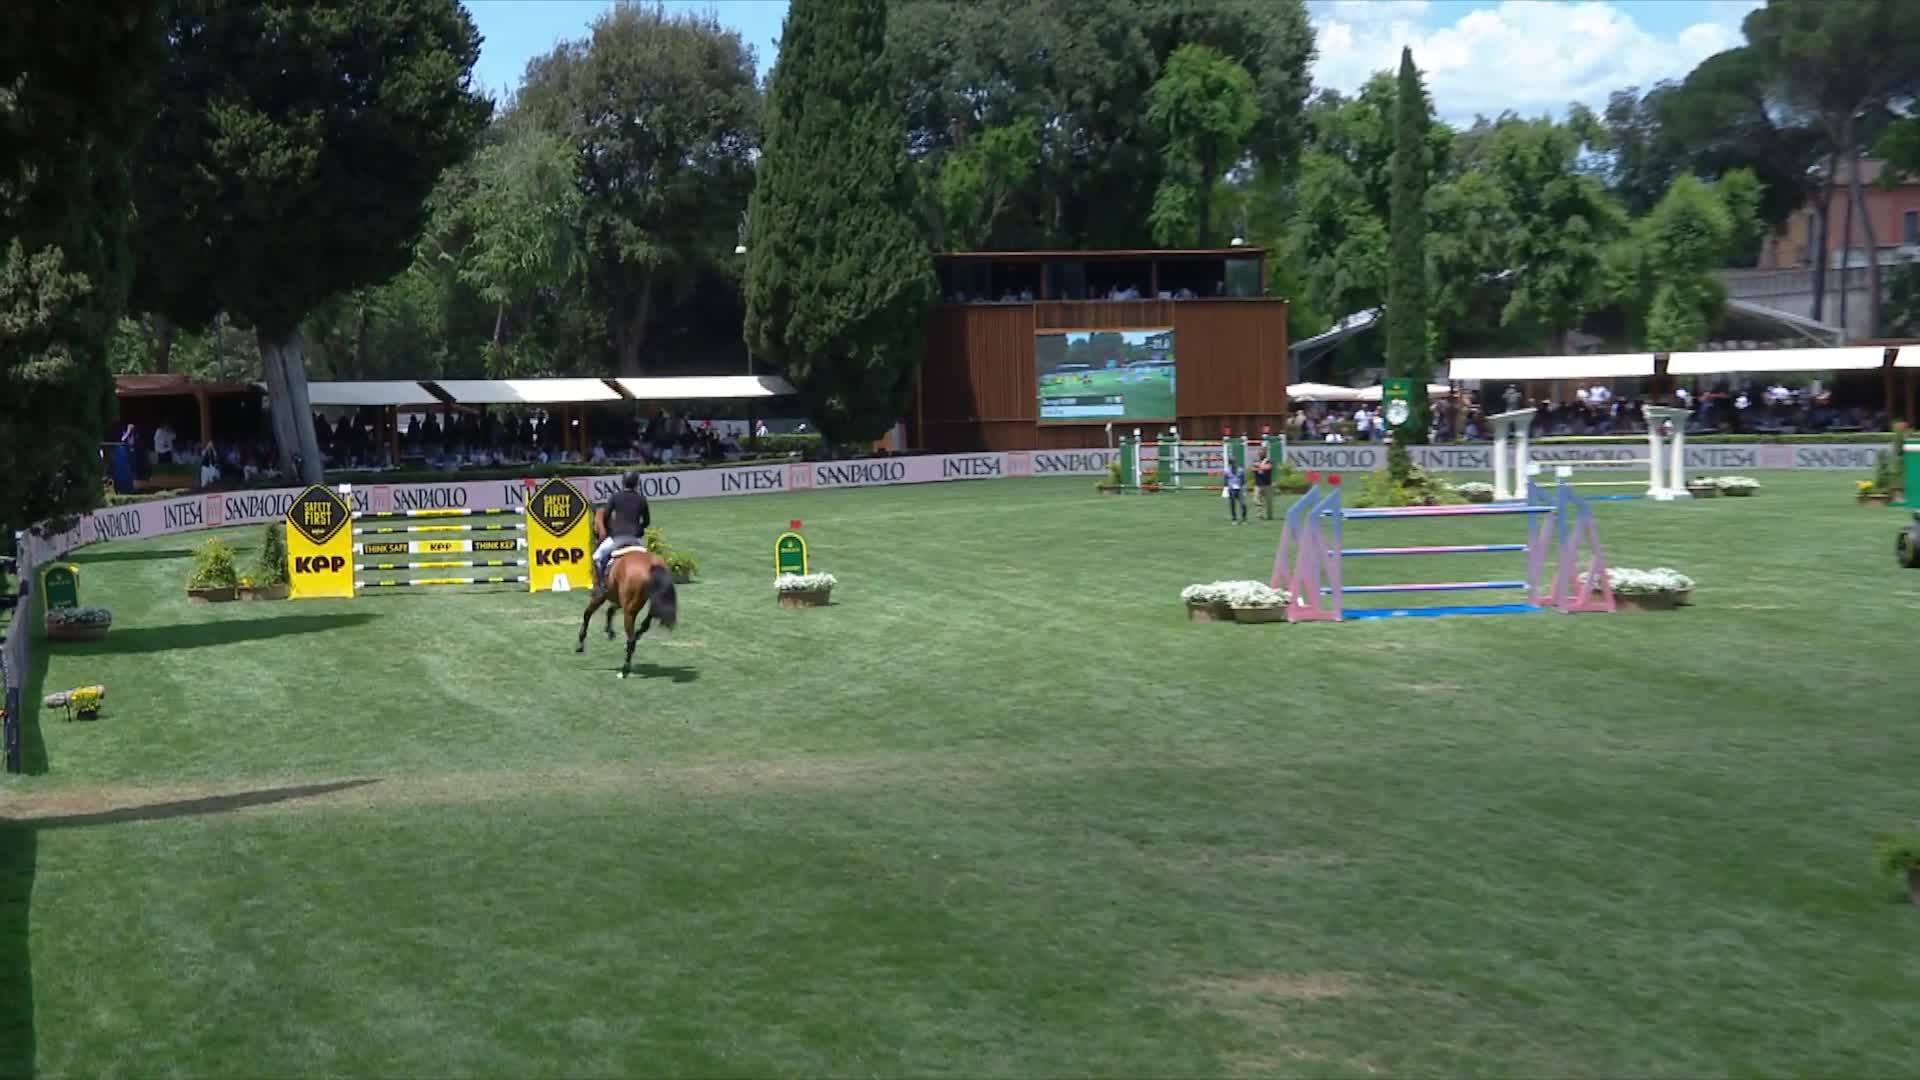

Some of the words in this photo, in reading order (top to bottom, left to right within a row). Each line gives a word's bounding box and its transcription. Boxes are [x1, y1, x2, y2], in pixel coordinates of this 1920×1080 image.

[1421, 449, 1490, 468] INTESA
[943, 456, 1001, 478] INTESA
[721, 469, 783, 492] INTESA
[817, 461, 905, 486] SANPAOLO
[304, 501, 331, 512] SAFETY
[393, 486, 467, 511] SANPAOLO
[164, 502, 202, 529] INTESA
[225, 493, 294, 521] SANPAOLO
[304, 512, 332, 525] FIRST
[544, 505, 570, 517] FIRST
[364, 545, 387, 554] THINK
[388, 543, 408, 553] SAFE
[475, 541, 499, 550] THINK
